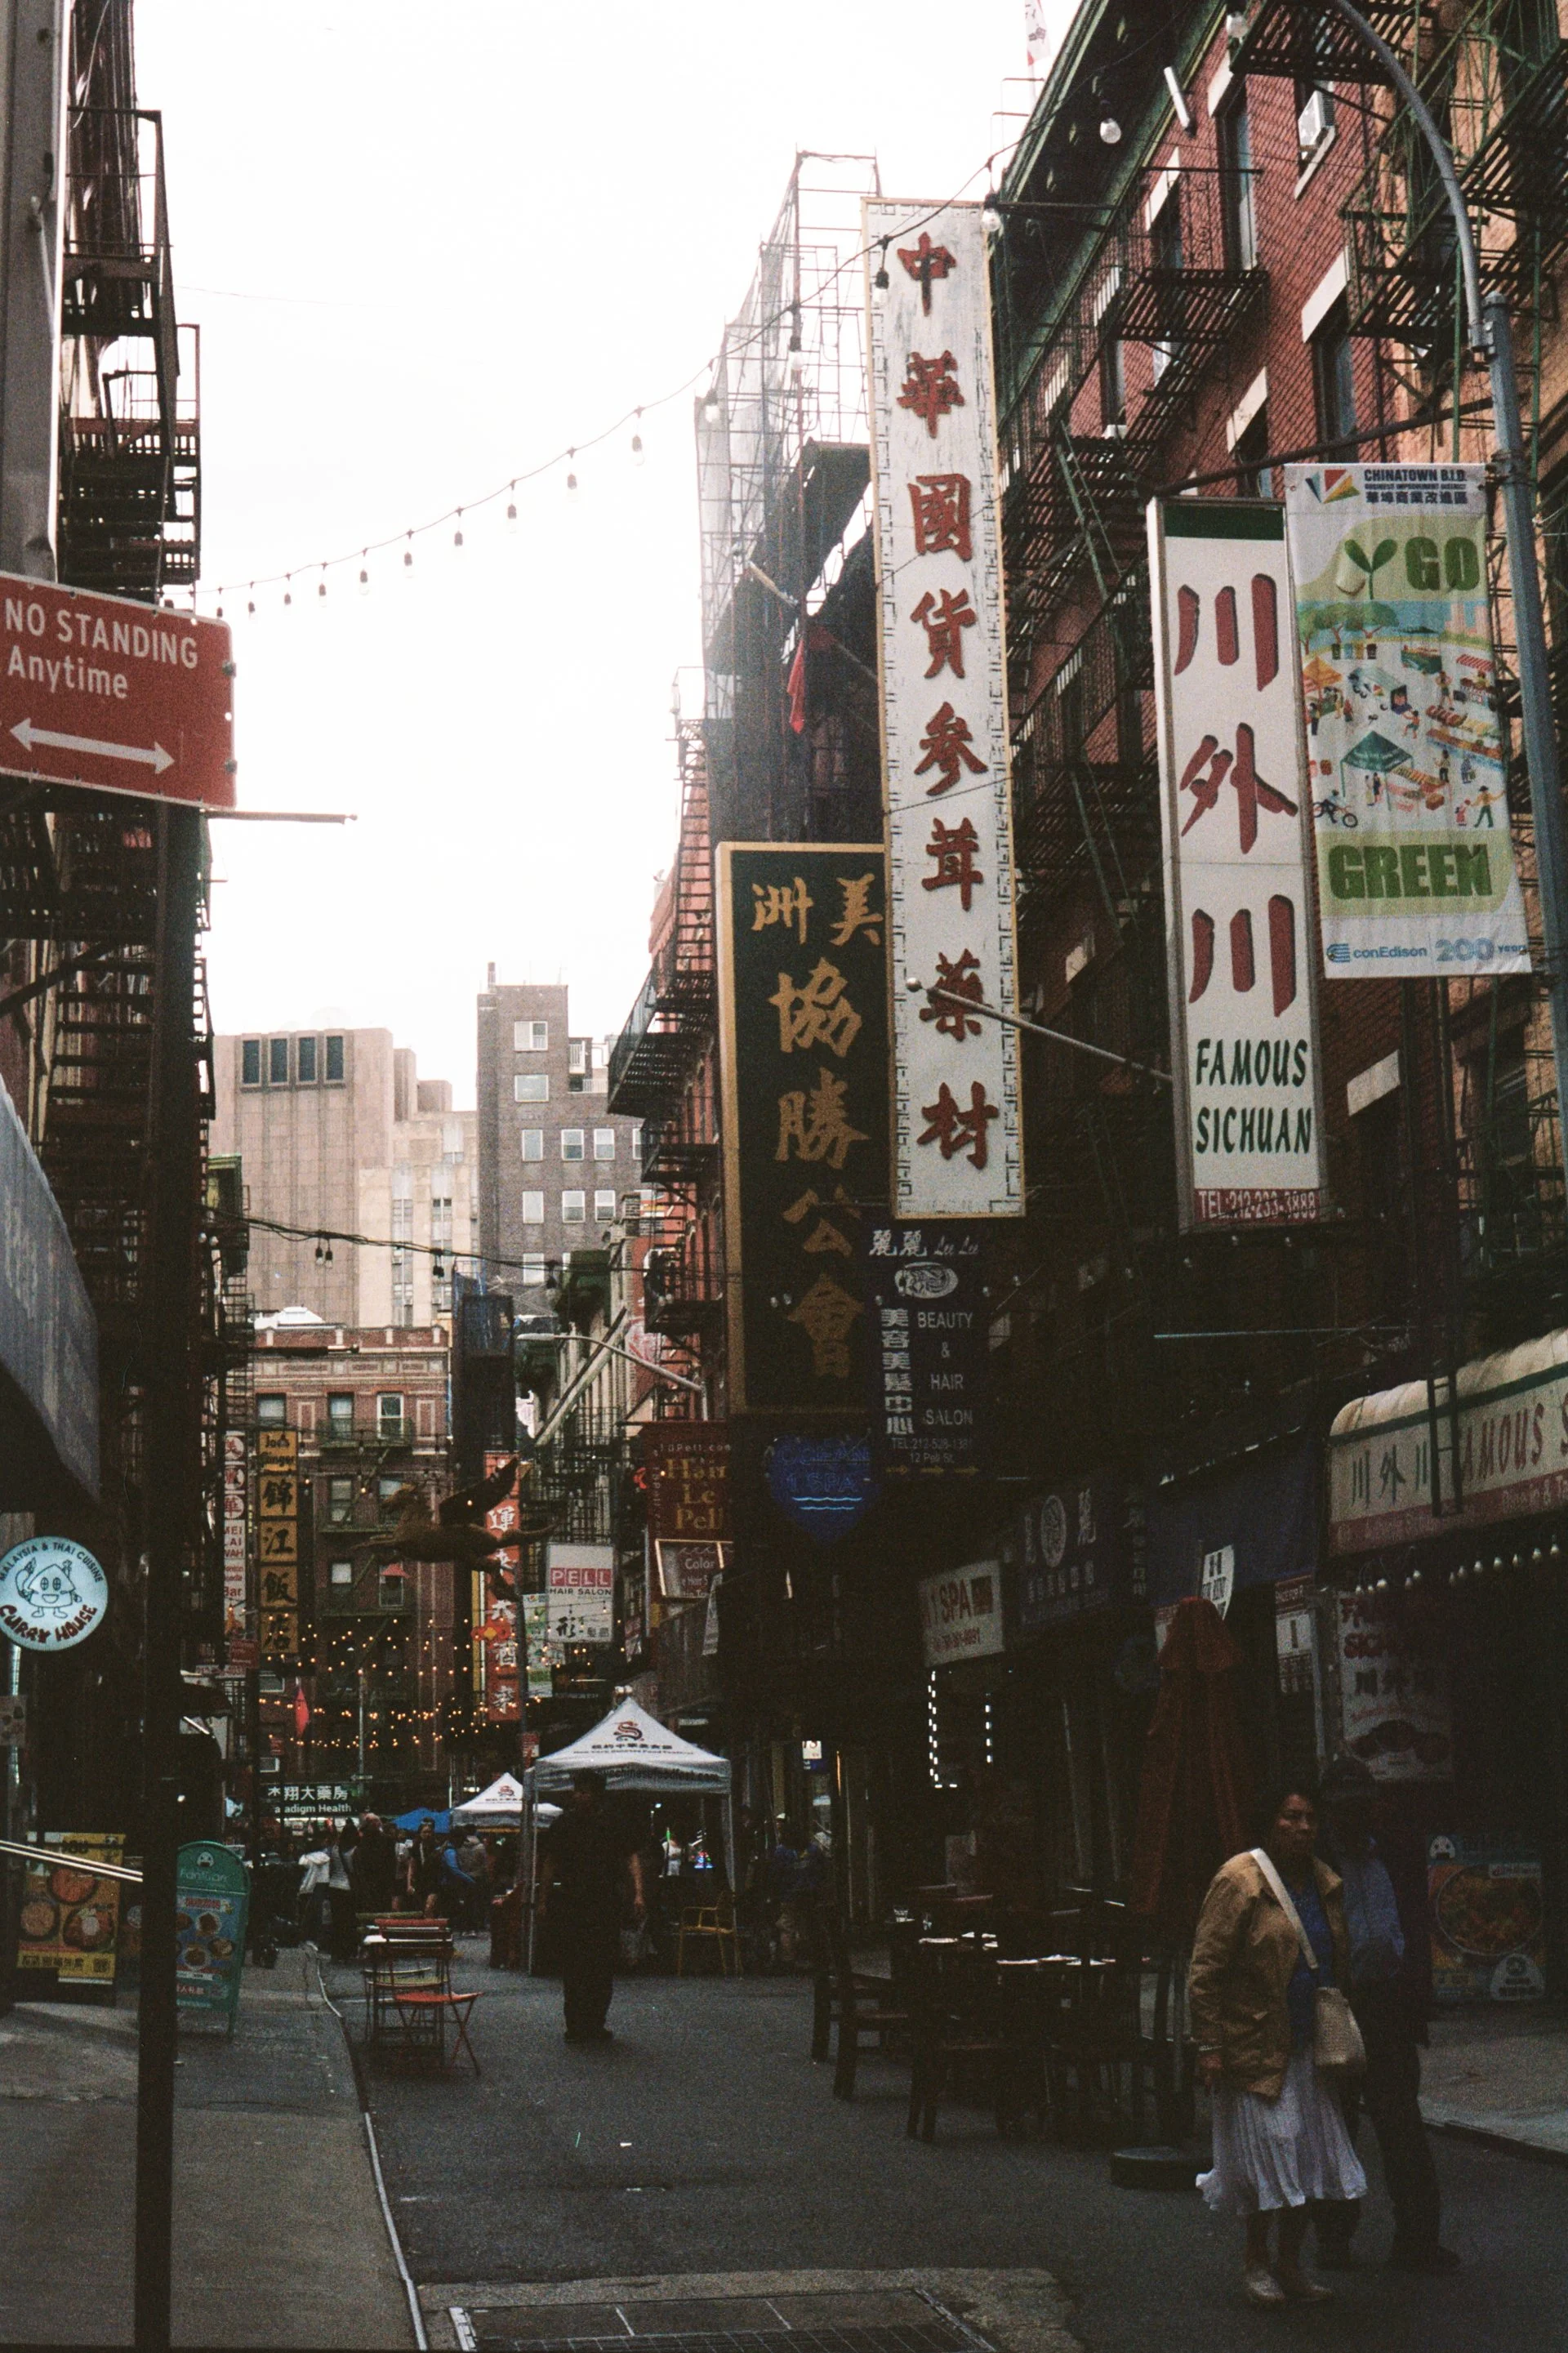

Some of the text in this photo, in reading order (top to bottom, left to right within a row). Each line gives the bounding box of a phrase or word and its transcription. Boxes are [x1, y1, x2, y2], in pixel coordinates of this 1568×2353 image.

[1365, 469, 1468, 481] CHINATOWN B.I.D.
[1405, 537, 1480, 590] GO
[5, 598, 198, 668] NO STANDING
[7, 644, 128, 700] Anytime
[1174, 573, 1298, 1017] 川外川
[1329, 844, 1493, 899] GREEN
[1353, 946, 1428, 959] conEdison
[1435, 938, 1494, 962] 200
[1196, 1038, 1307, 1087] FAMOUS
[1195, 1106, 1312, 1154] SICHUAN
[917, 1312, 973, 1329] BEAUTY
[941, 1341, 951, 1358] &
[930, 1374, 964, 1390] HAIR
[925, 1409, 973, 1426] SALON
[1462, 1402, 1544, 1481] AMOUS
[0, 1542, 104, 1583] MALAYSIA & THAI CUISINE
[552, 1569, 611, 1586] PELL
[939, 1578, 973, 1624] SPA
[0, 1604, 97, 1643] CURRY HOUSE
[318, 1803, 351, 1813] Health
